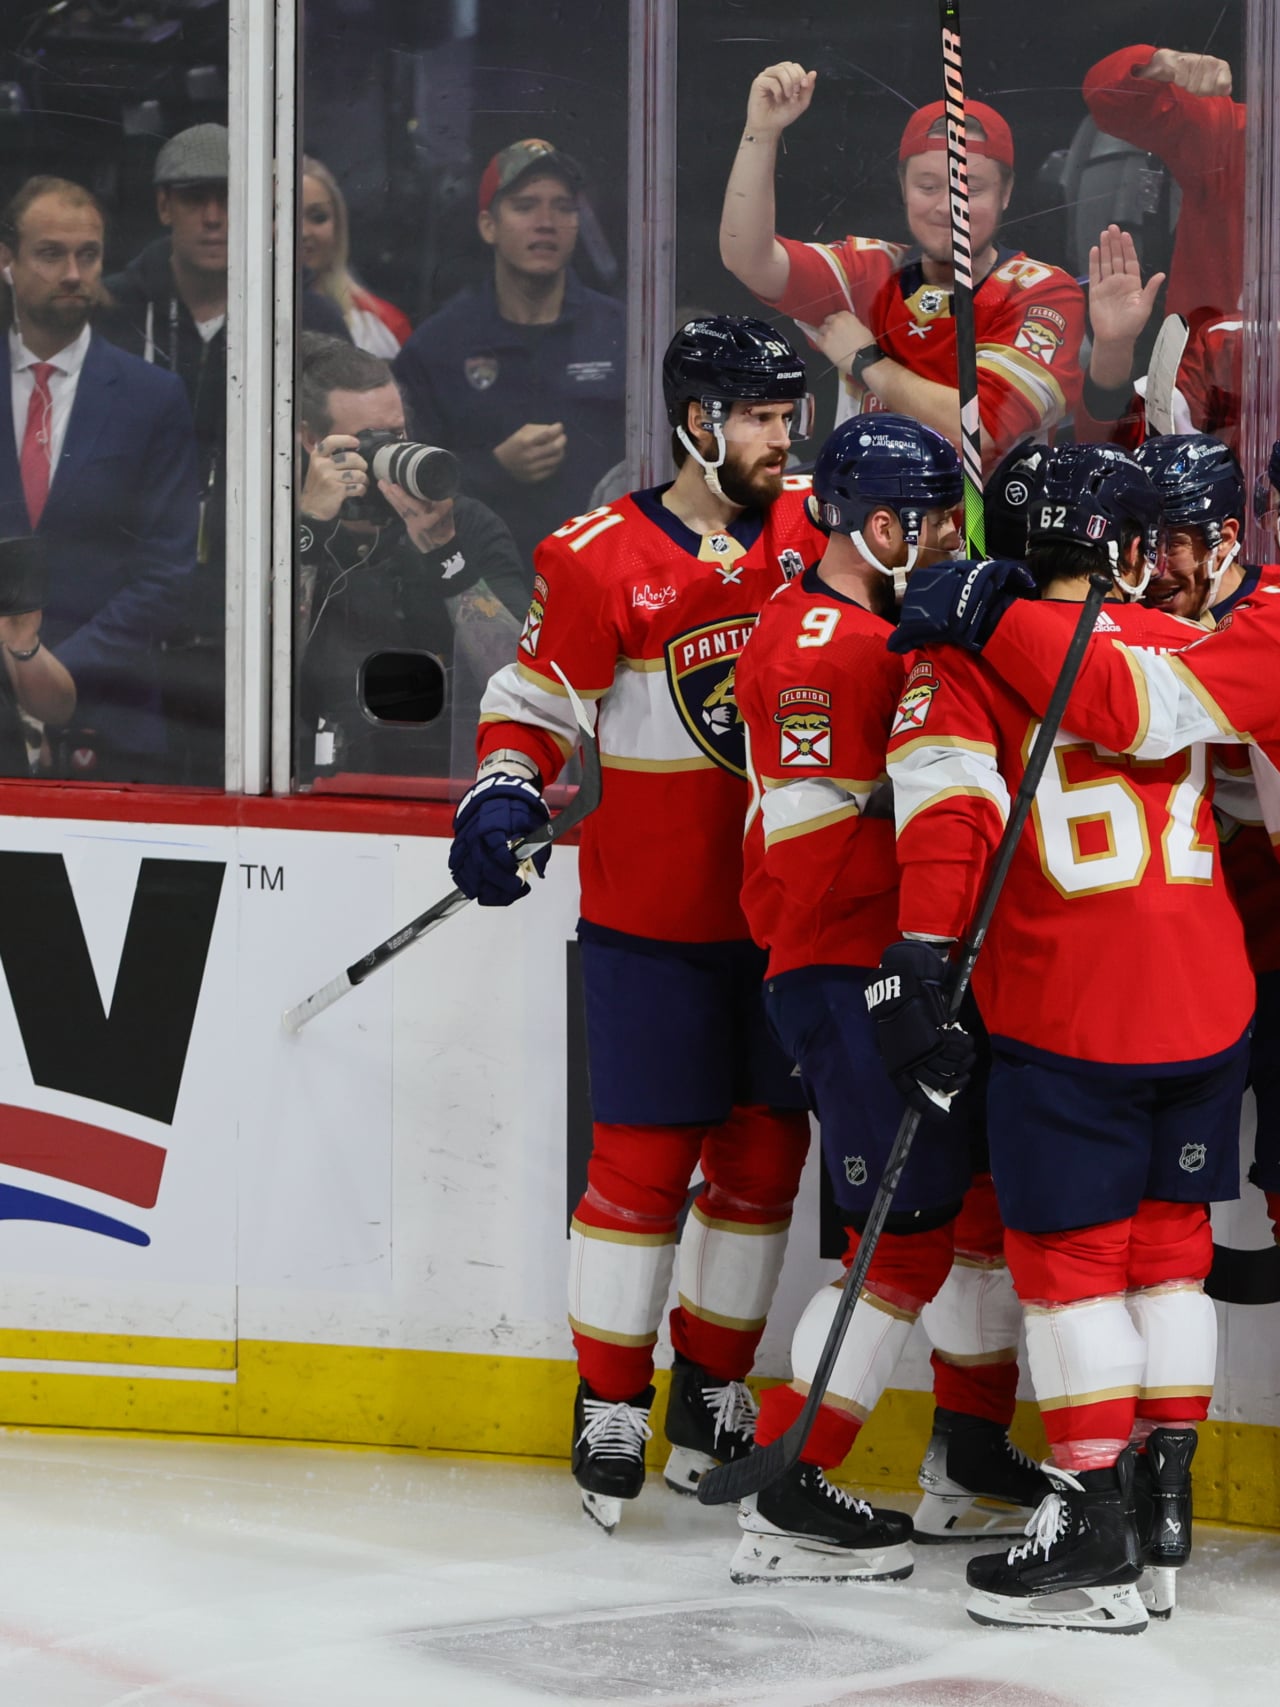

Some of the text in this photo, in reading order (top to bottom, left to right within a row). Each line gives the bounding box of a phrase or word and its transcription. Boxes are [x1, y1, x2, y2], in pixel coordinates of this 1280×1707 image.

[942, 27, 973, 290] WARRIOR
[872, 440, 917, 449] LAUDERDALE
[552, 505, 625, 553] 91
[1040, 506, 1066, 529] 62
[796, 606, 841, 649] 9
[785, 690, 824, 702] FLORIDA
[240, 864, 285, 891] TM
